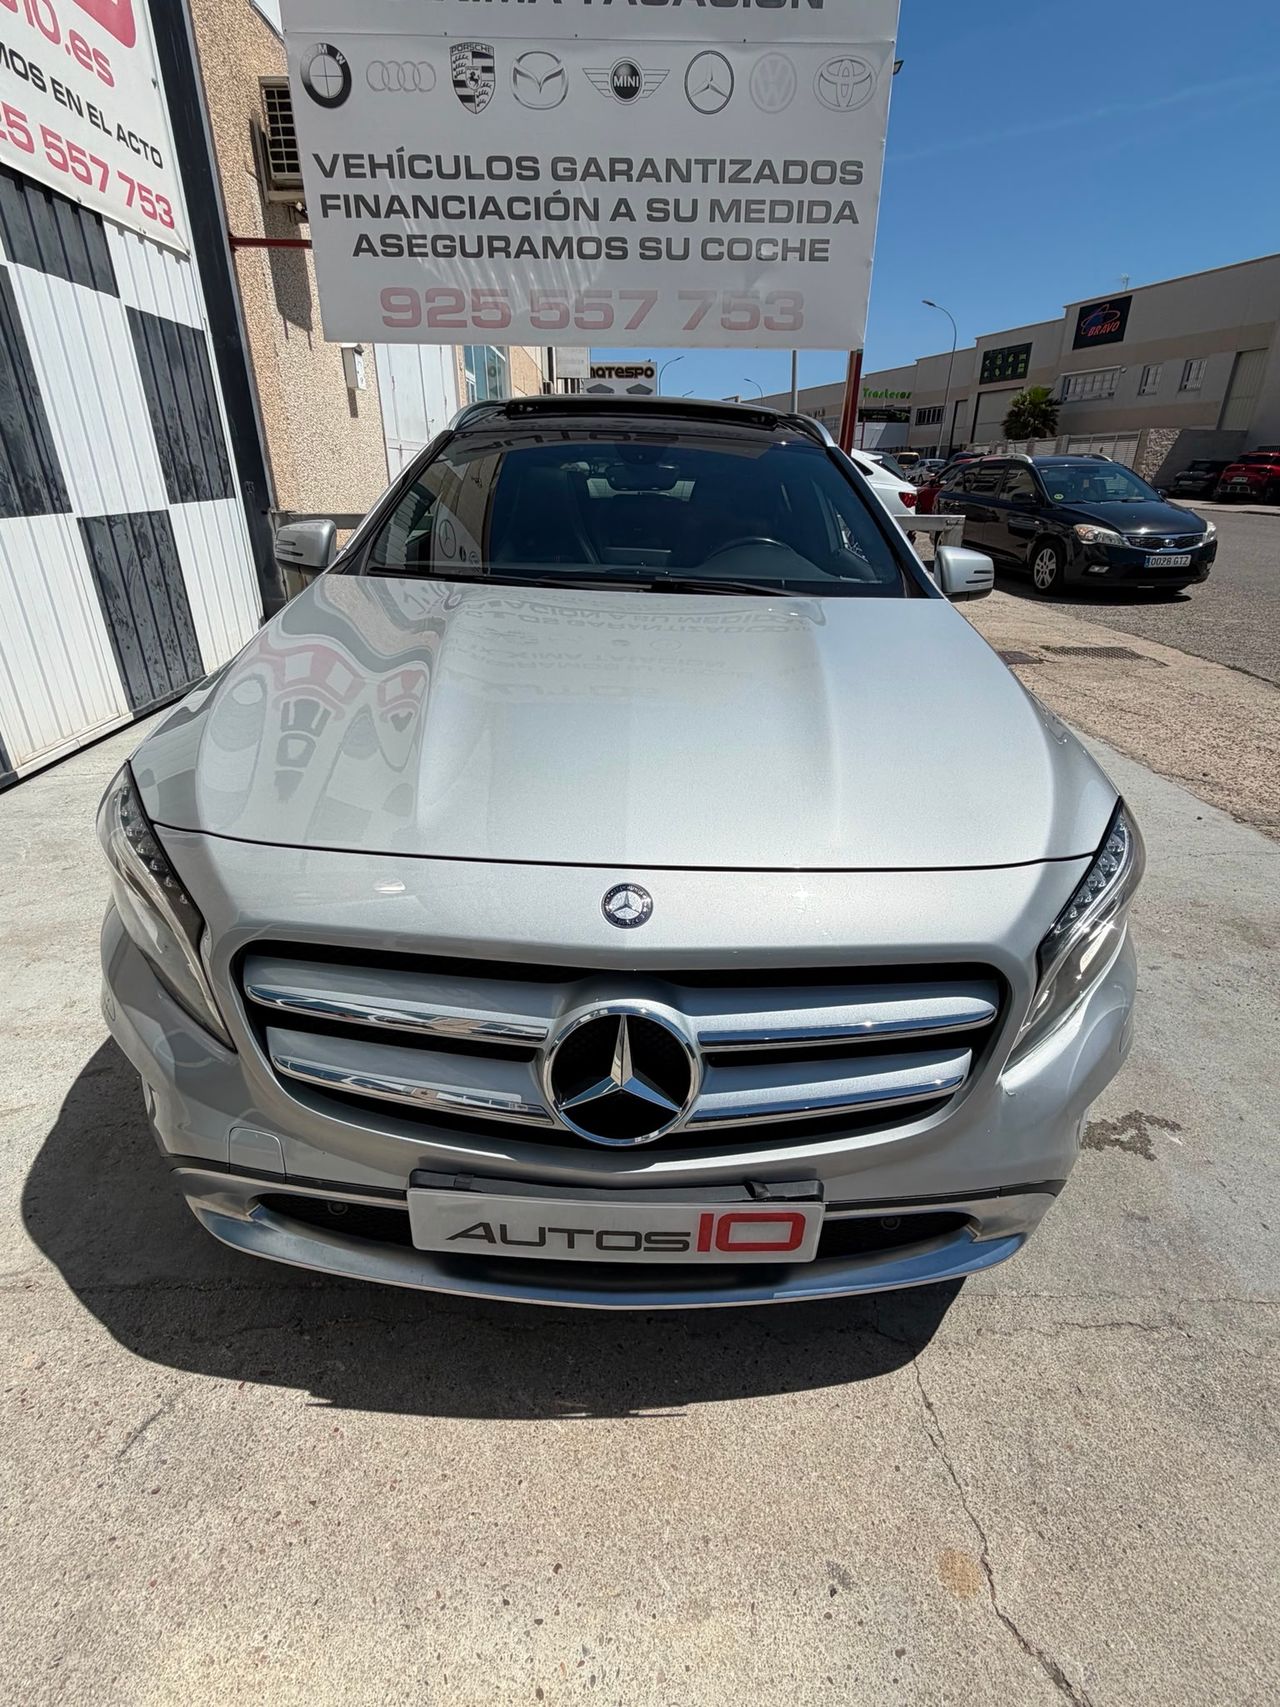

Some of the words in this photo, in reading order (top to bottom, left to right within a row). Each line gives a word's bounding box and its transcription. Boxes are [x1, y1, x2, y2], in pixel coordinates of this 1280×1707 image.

[613, 75, 639, 88] MINI
[50, 76, 84, 118] EN
[86, 101, 112, 137] EL
[117, 123, 163, 169] ACTO
[40, 124, 110, 194] 557
[117, 170, 175, 230] 753
[312, 146, 540, 181] VEHÍCULOS
[551, 156, 864, 186] GARANTIZADOS
[320, 189, 600, 222] FINANCIACIÓN
[609, 198, 637, 222] A
[646, 198, 698, 223] SU
[709, 199, 860, 225] MEDIDA
[352, 233, 629, 261] ASEGURAMOS
[639, 237, 690, 262] SU
[700, 237, 830, 262] COCHE
[379, 286, 513, 330] 925
[529, 289, 659, 331] 557
[677, 289, 804, 332] 753
[1087, 320, 1121, 337] BRAVO
